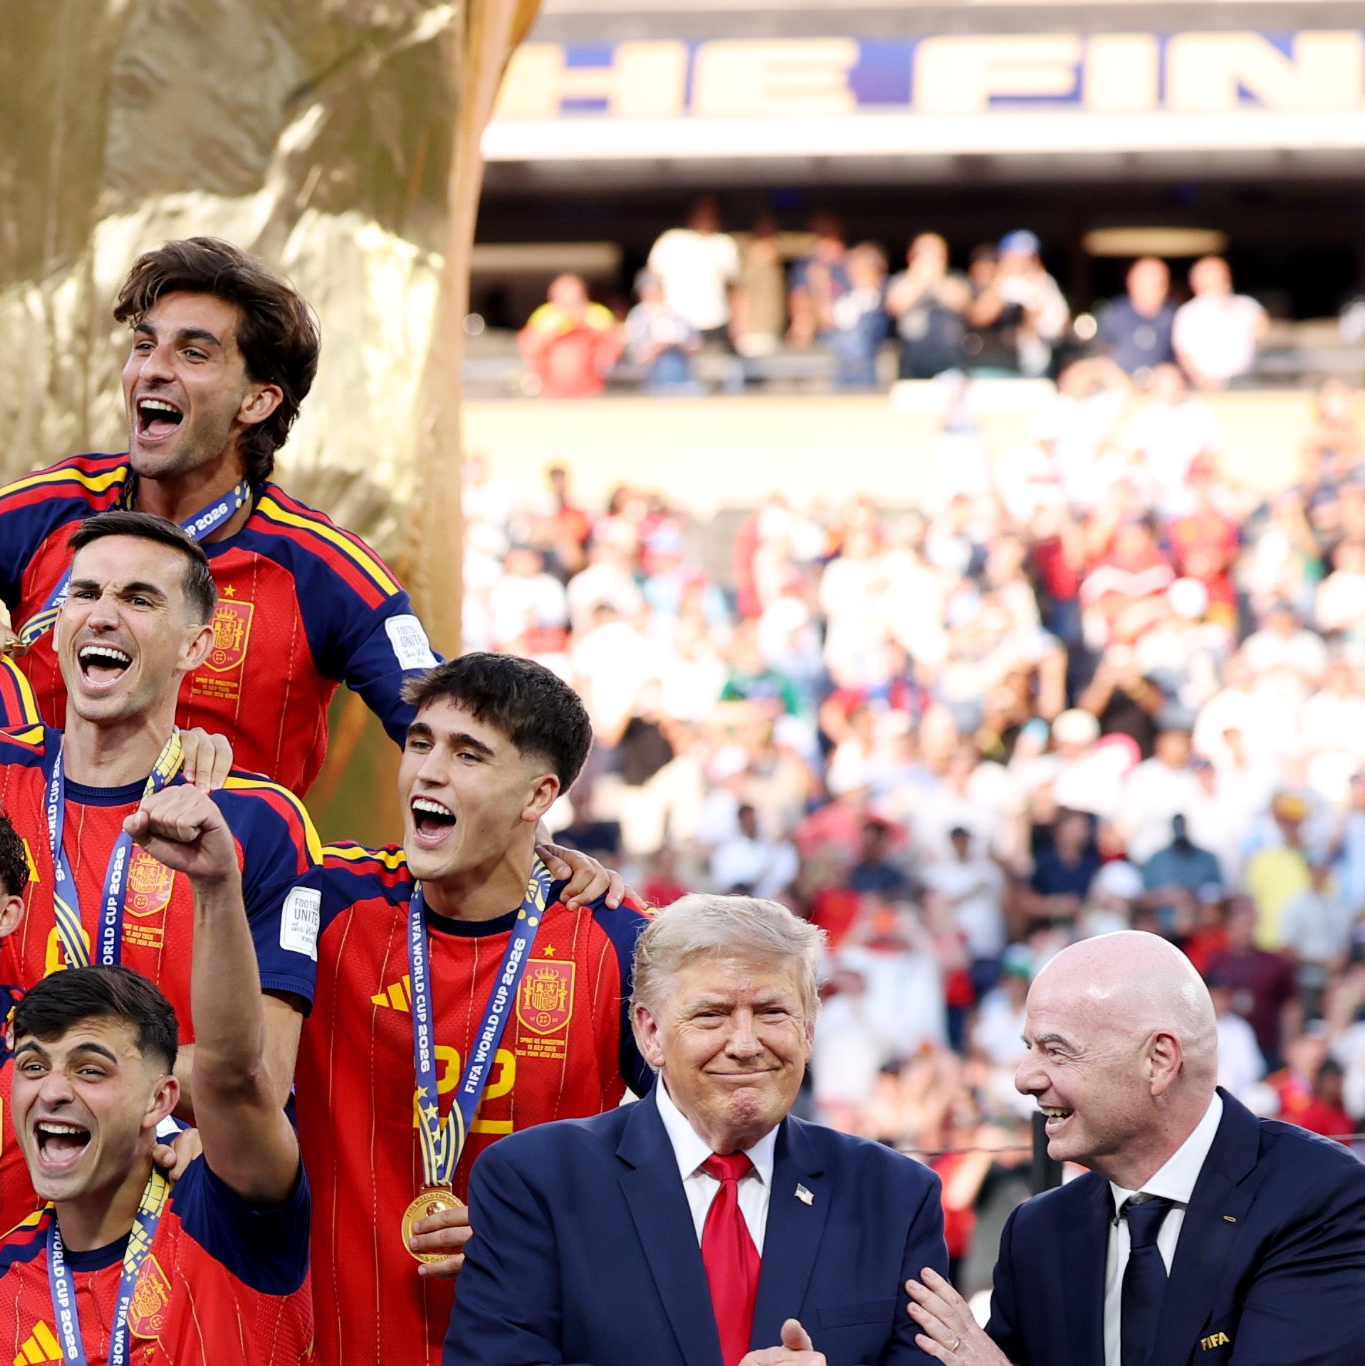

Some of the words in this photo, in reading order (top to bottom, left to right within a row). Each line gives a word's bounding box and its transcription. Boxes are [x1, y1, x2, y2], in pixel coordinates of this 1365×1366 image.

[912, 33, 1365, 112] FIN
[195, 503, 229, 532] 2026
[49, 782, 60, 803] CUP
[109, 846, 126, 895] 2026
[105, 897, 118, 928] CUP
[294, 908, 318, 926] UNITE
[412, 911, 422, 942] FIFA
[102, 927, 115, 966] ORLD
[501, 937, 527, 987] 2026
[412, 941, 425, 992] WORLD
[416, 991, 428, 1023] CUP
[491, 988, 510, 1017] CUP
[418, 1023, 431, 1074] 2026
[472, 1012, 501, 1067] WORLD
[412, 1044, 517, 1135] 22
[464, 1063, 482, 1095] FIFA
[52, 1230, 66, 1278] WORLD
[55, 1279, 70, 1308] CUP
[115, 1296, 130, 1329] FIFA
[60, 1310, 79, 1361] 2026
[1200, 1331, 1230, 1352] FIFA
